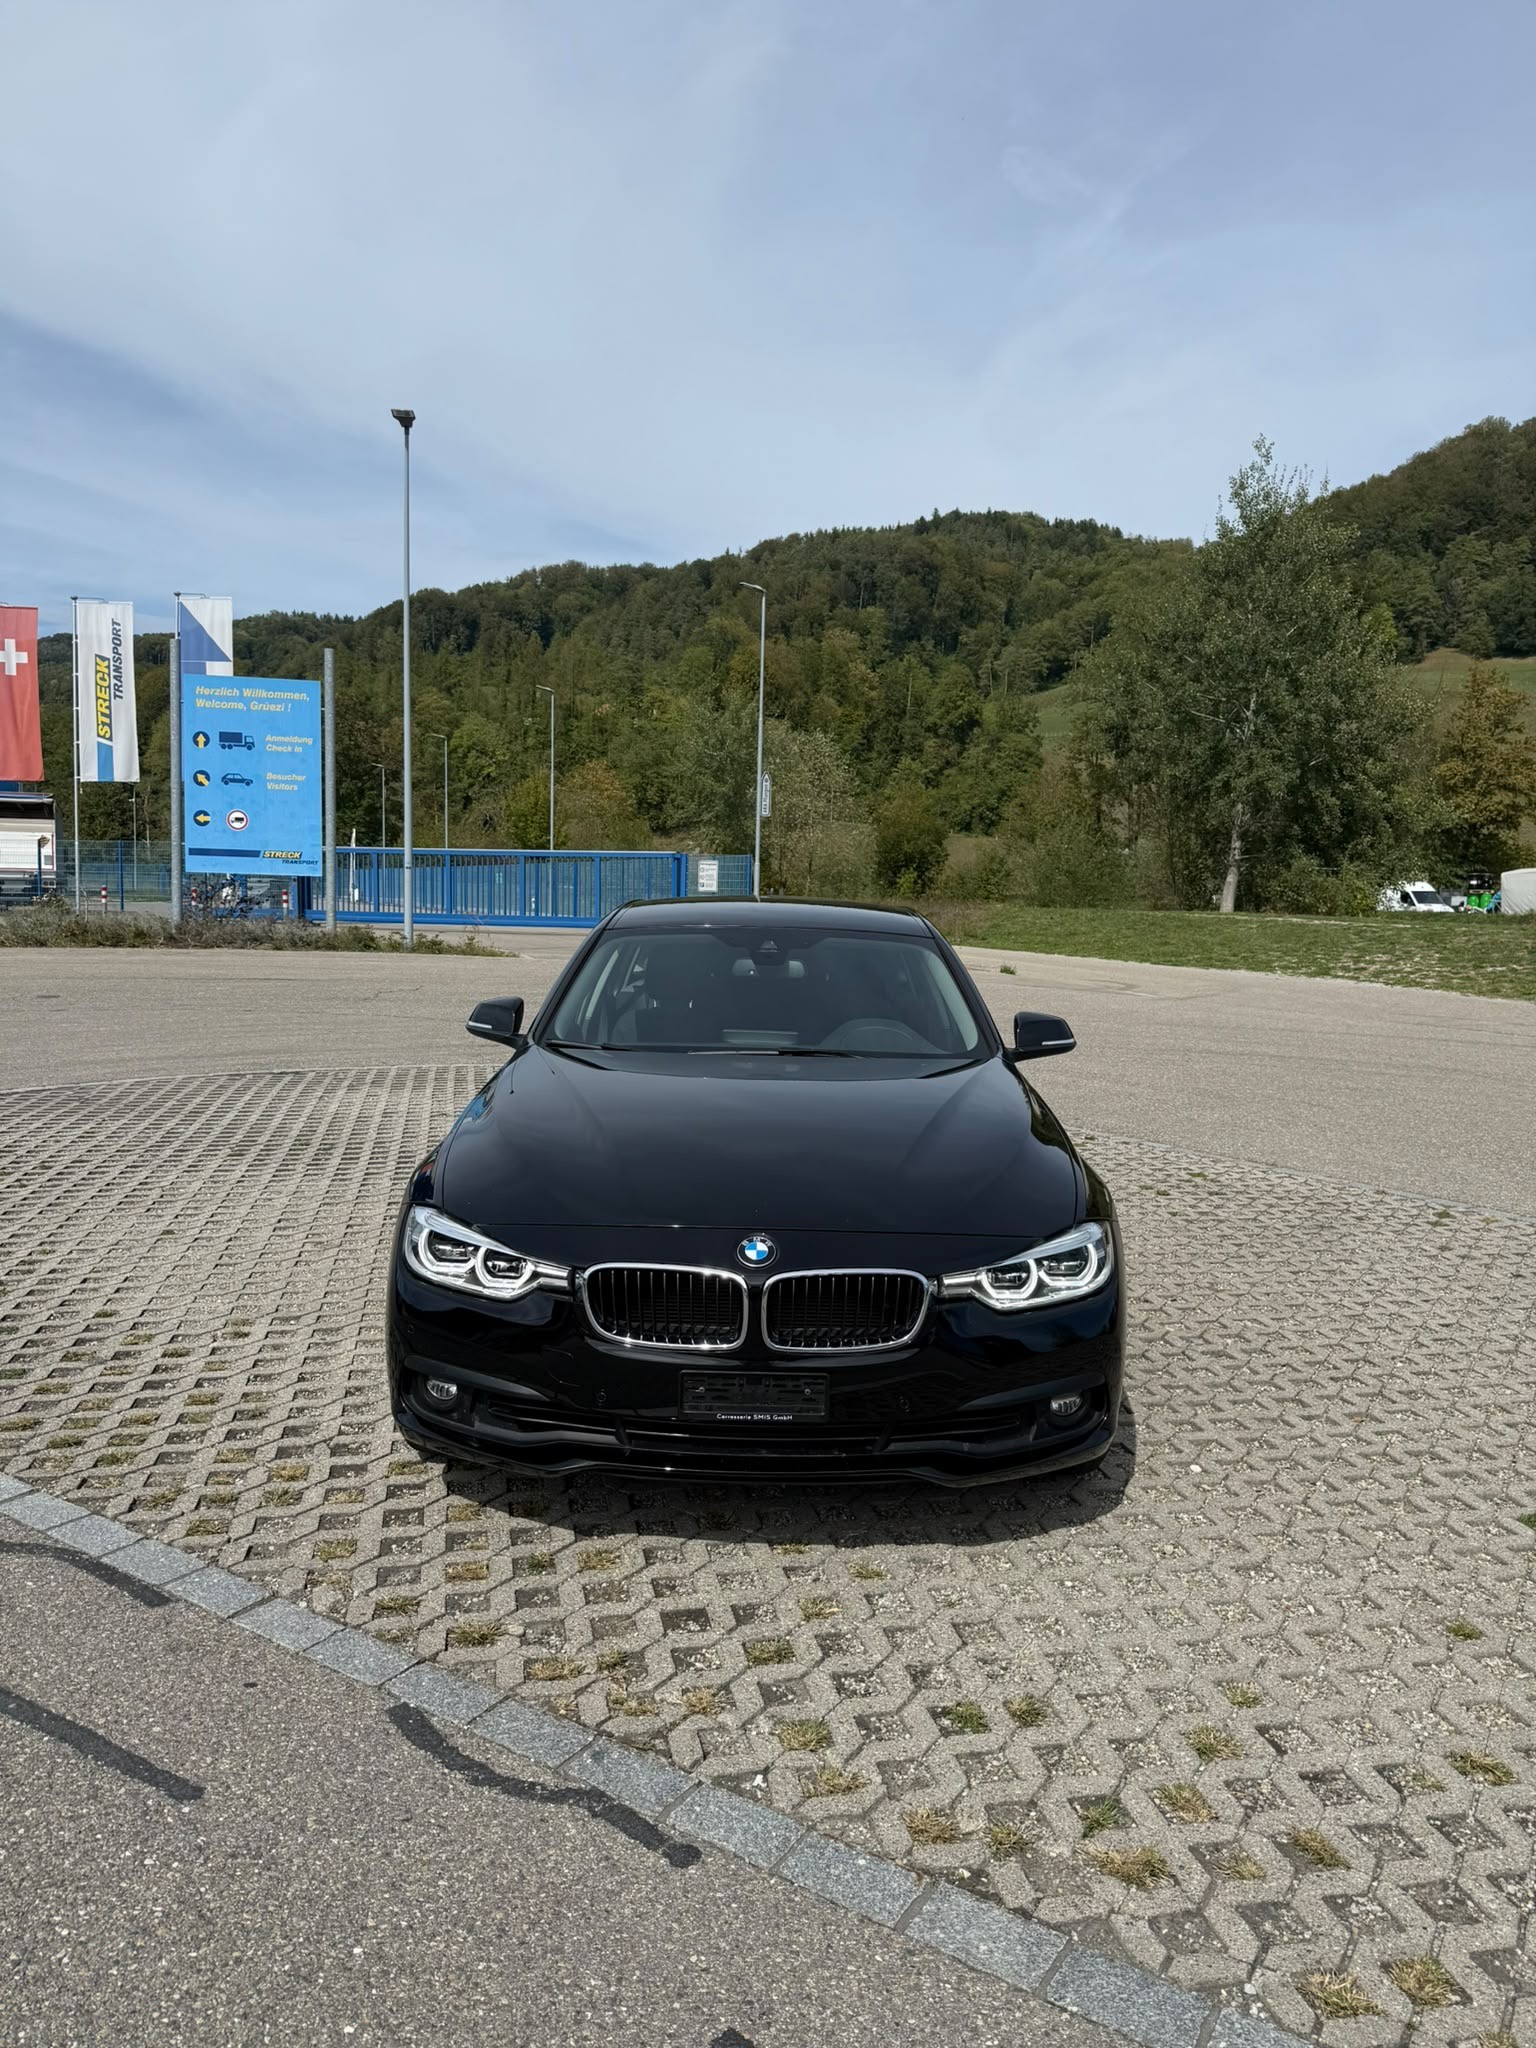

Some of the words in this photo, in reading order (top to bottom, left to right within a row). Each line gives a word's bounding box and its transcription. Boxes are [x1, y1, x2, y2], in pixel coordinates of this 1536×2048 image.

[112, 618, 123, 700] TRANSPORT
[96, 656, 111, 739] STRECK
[195, 686, 240, 697] Herzlich
[242, 687, 310, 701] Willkommen,
[195, 698, 247, 711] Welcome,
[250, 701, 285, 712] Grüezi
[265, 734, 313, 745] Anmeldung
[265, 744, 292, 753] Check
[265, 772, 306, 781] Besucher
[266, 782, 298, 791] Visitors
[263, 850, 302, 859] STRECK
